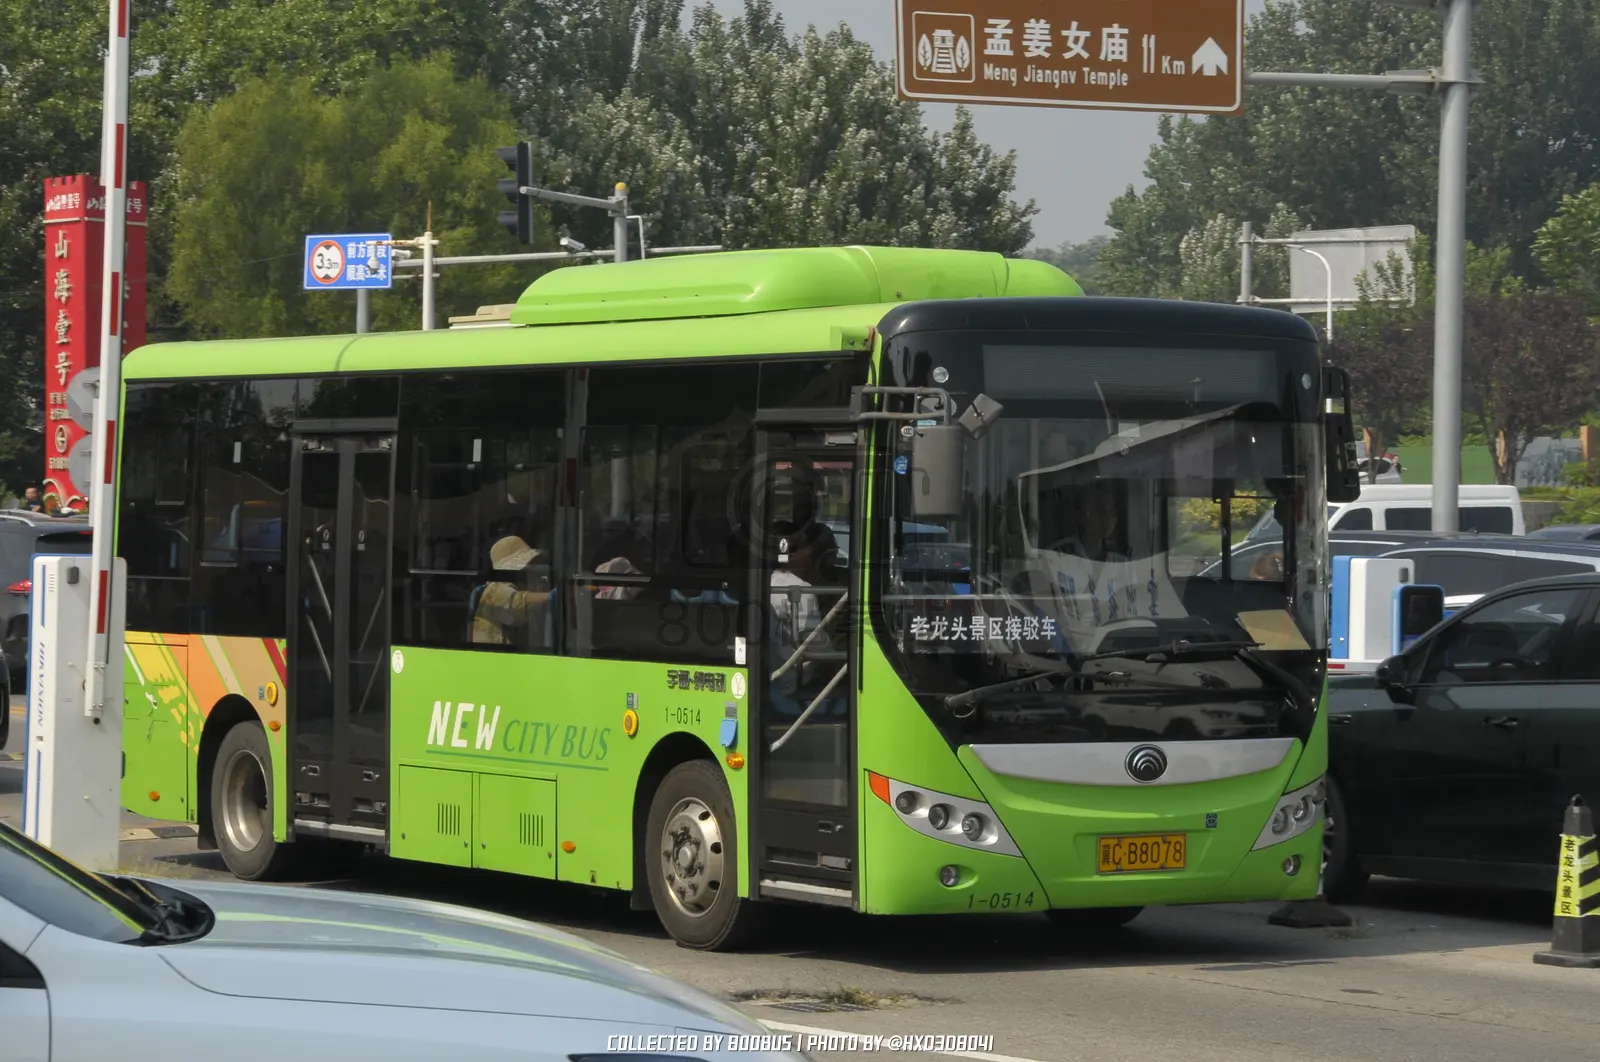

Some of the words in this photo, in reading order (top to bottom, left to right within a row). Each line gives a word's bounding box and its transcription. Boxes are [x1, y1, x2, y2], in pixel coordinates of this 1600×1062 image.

[983, 18, 1129, 62] 孟姜女庙
[1142, 34, 1155, 74] 11
[1161, 56, 1186, 75] Km
[983, 62, 1018, 87] Meng
[1023, 64, 1077, 89] Jiangnv
[1083, 67, 1129, 90] Temple
[910, 615, 1057, 641] 老龙头景区接驳车
[427, 700, 501, 750] NEW
[503, 719, 560, 756] CITY
[561, 725, 612, 761] BUS
[665, 706, 701, 726] 1-0514
[1561, 839, 1575, 914] 老龙头景区
[968, 891, 1034, 909] 1-0514
